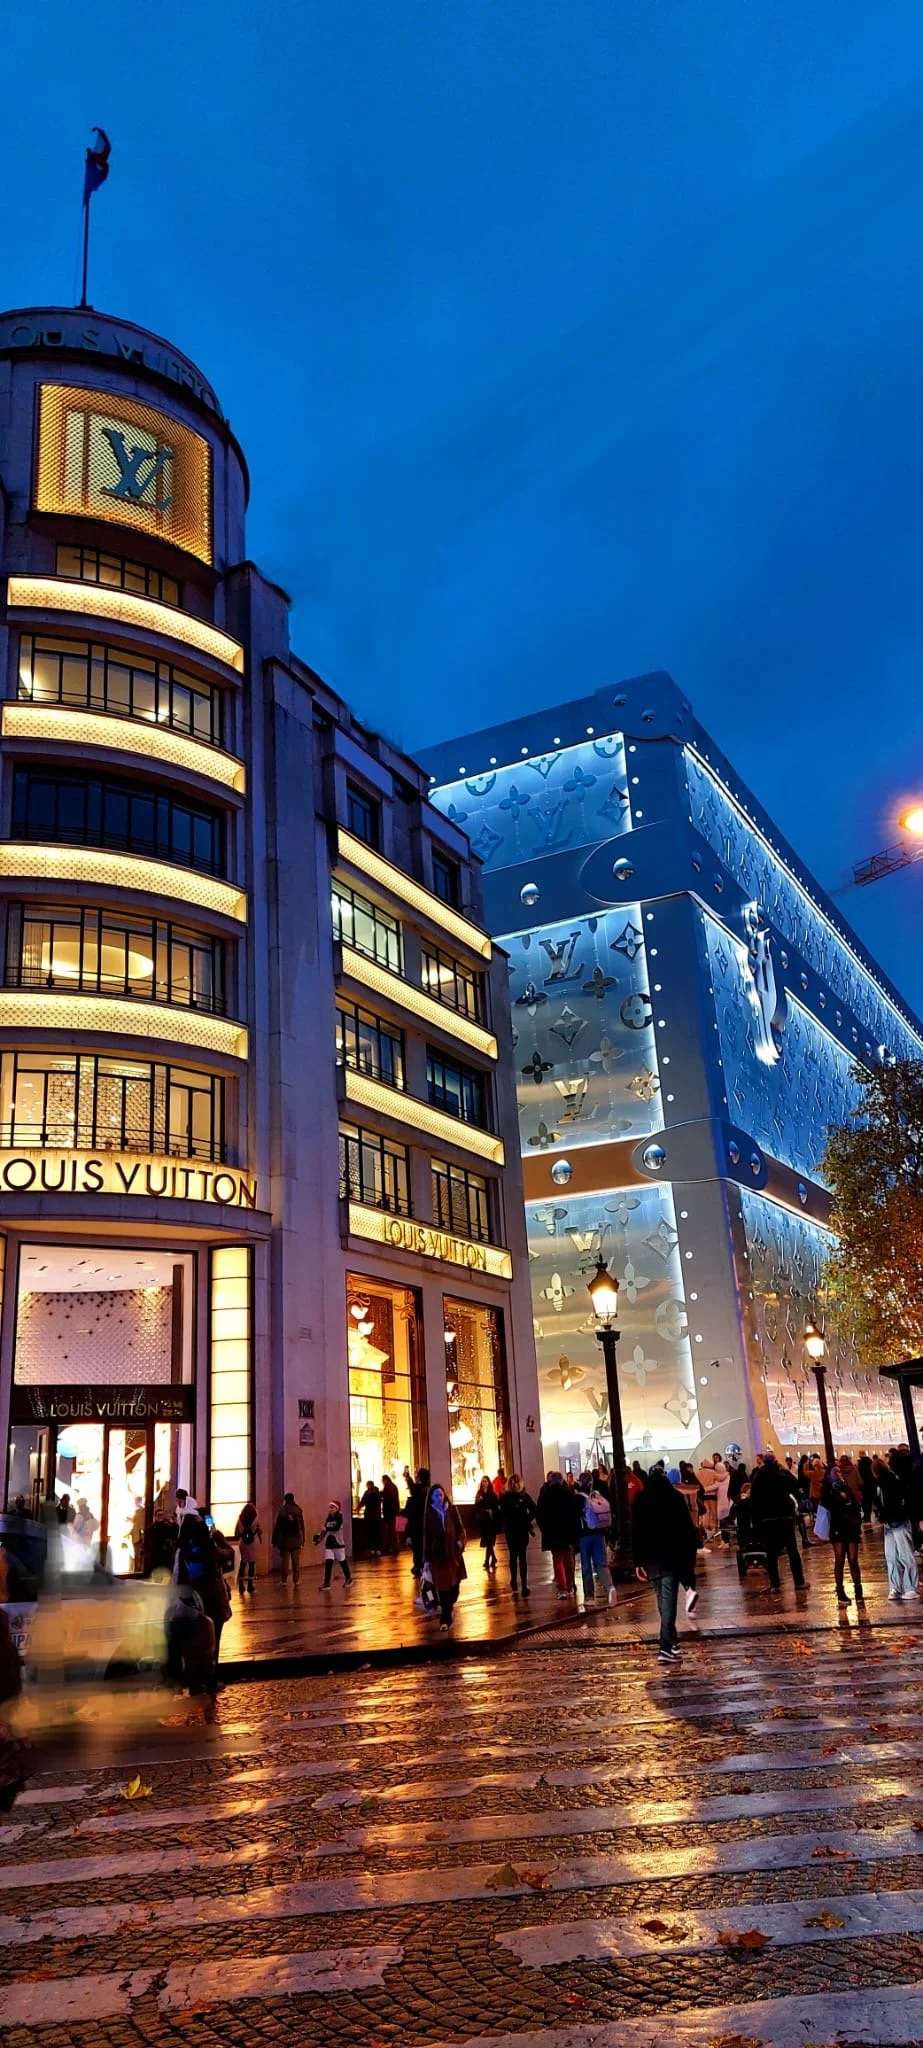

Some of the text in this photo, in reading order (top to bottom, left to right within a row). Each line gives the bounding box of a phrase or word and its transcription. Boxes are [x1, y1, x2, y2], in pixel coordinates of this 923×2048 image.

[0, 1158, 258, 1209] OUIS VUITTON
[383, 1217, 487, 1271] LOUIS VUITTON
[50, 1403, 93, 1417] LOUIS
[96, 1402, 159, 1417] VUITTON
